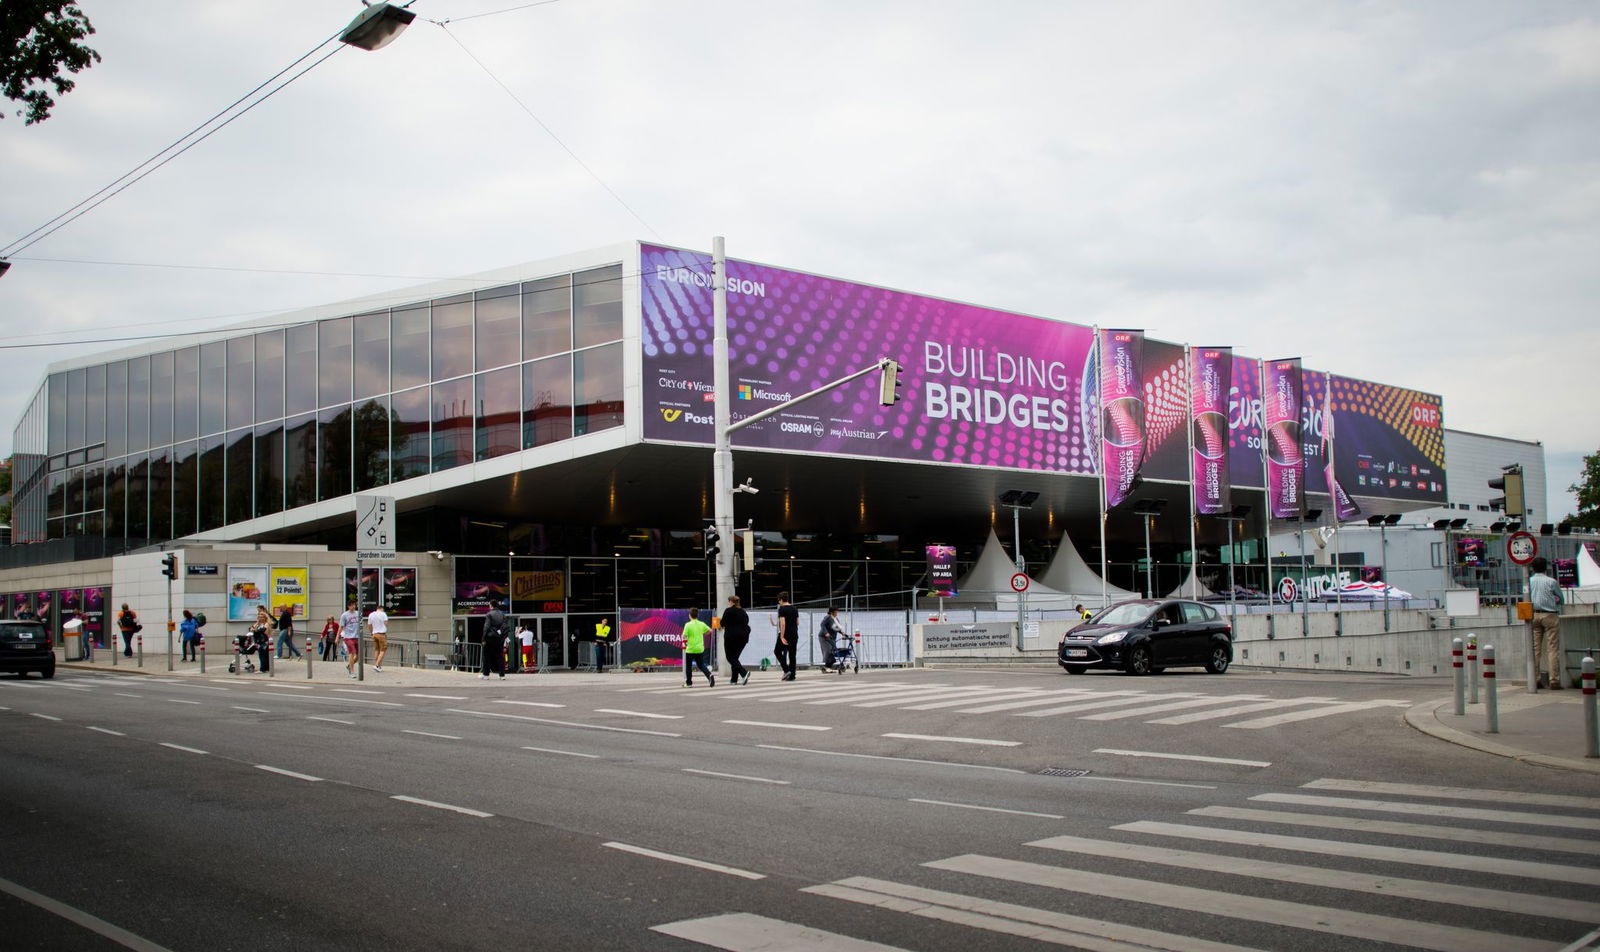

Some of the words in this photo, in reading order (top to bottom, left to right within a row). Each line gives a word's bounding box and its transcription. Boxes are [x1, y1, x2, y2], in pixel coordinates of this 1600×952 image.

[924, 340, 1067, 391] BUILDING
[692, 381, 715, 392] Vien
[753, 389, 792, 402] Microsoft
[925, 381, 1069, 432] BRIDGES
[684, 412, 714, 425] Post
[1413, 406, 1436, 424] ORF
[780, 422, 812, 434] OSRAM
[830, 426, 875, 439] myAustrian
[1119, 451, 1127, 490] BUILDING
[1211, 462, 1219, 499] BRIDGES
[1288, 468, 1297, 503] BRIDGES
[357, 551, 380, 559] Einordnen
[380, 551, 395, 559] lassen
[276, 586, 283, 594] 12
[638, 634, 653, 642] VIP
[653, 634, 682, 642] ENTRA
